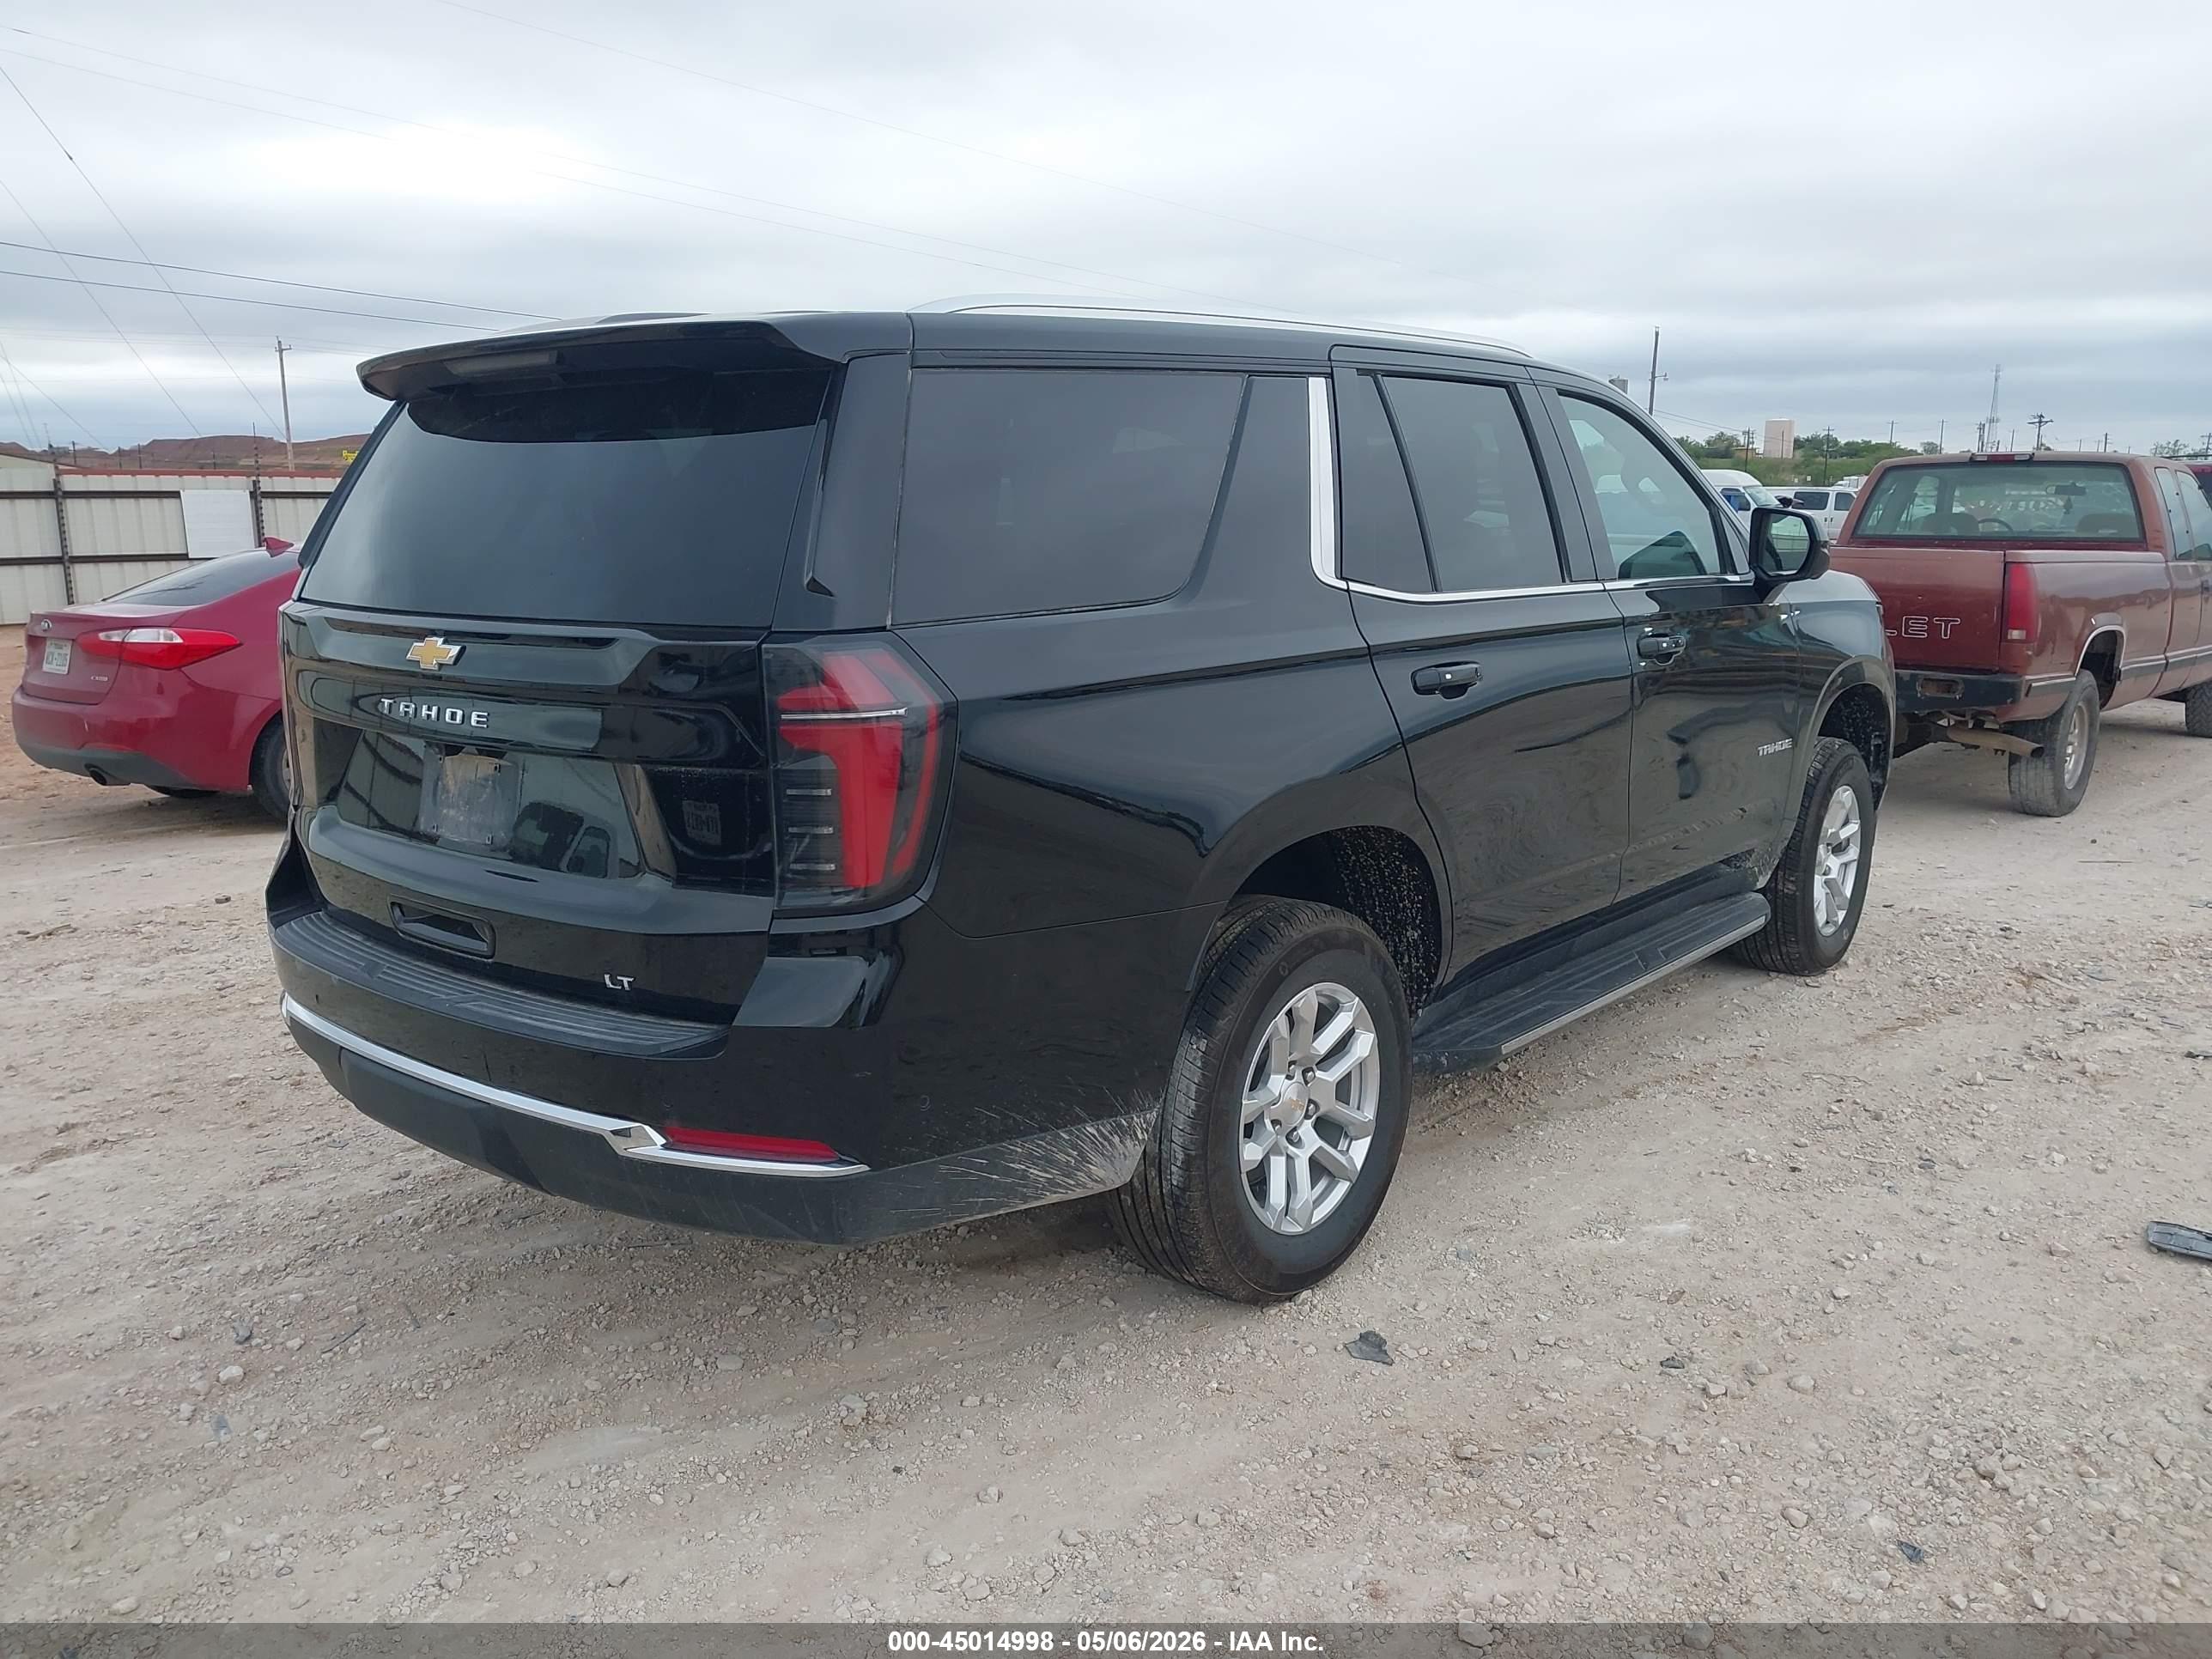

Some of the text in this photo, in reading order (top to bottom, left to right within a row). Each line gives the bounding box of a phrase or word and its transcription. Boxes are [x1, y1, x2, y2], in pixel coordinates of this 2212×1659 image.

[379, 698, 489, 729] TAHOE
[1757, 738, 1793, 757] TAHOE
[604, 973, 635, 991] LT
